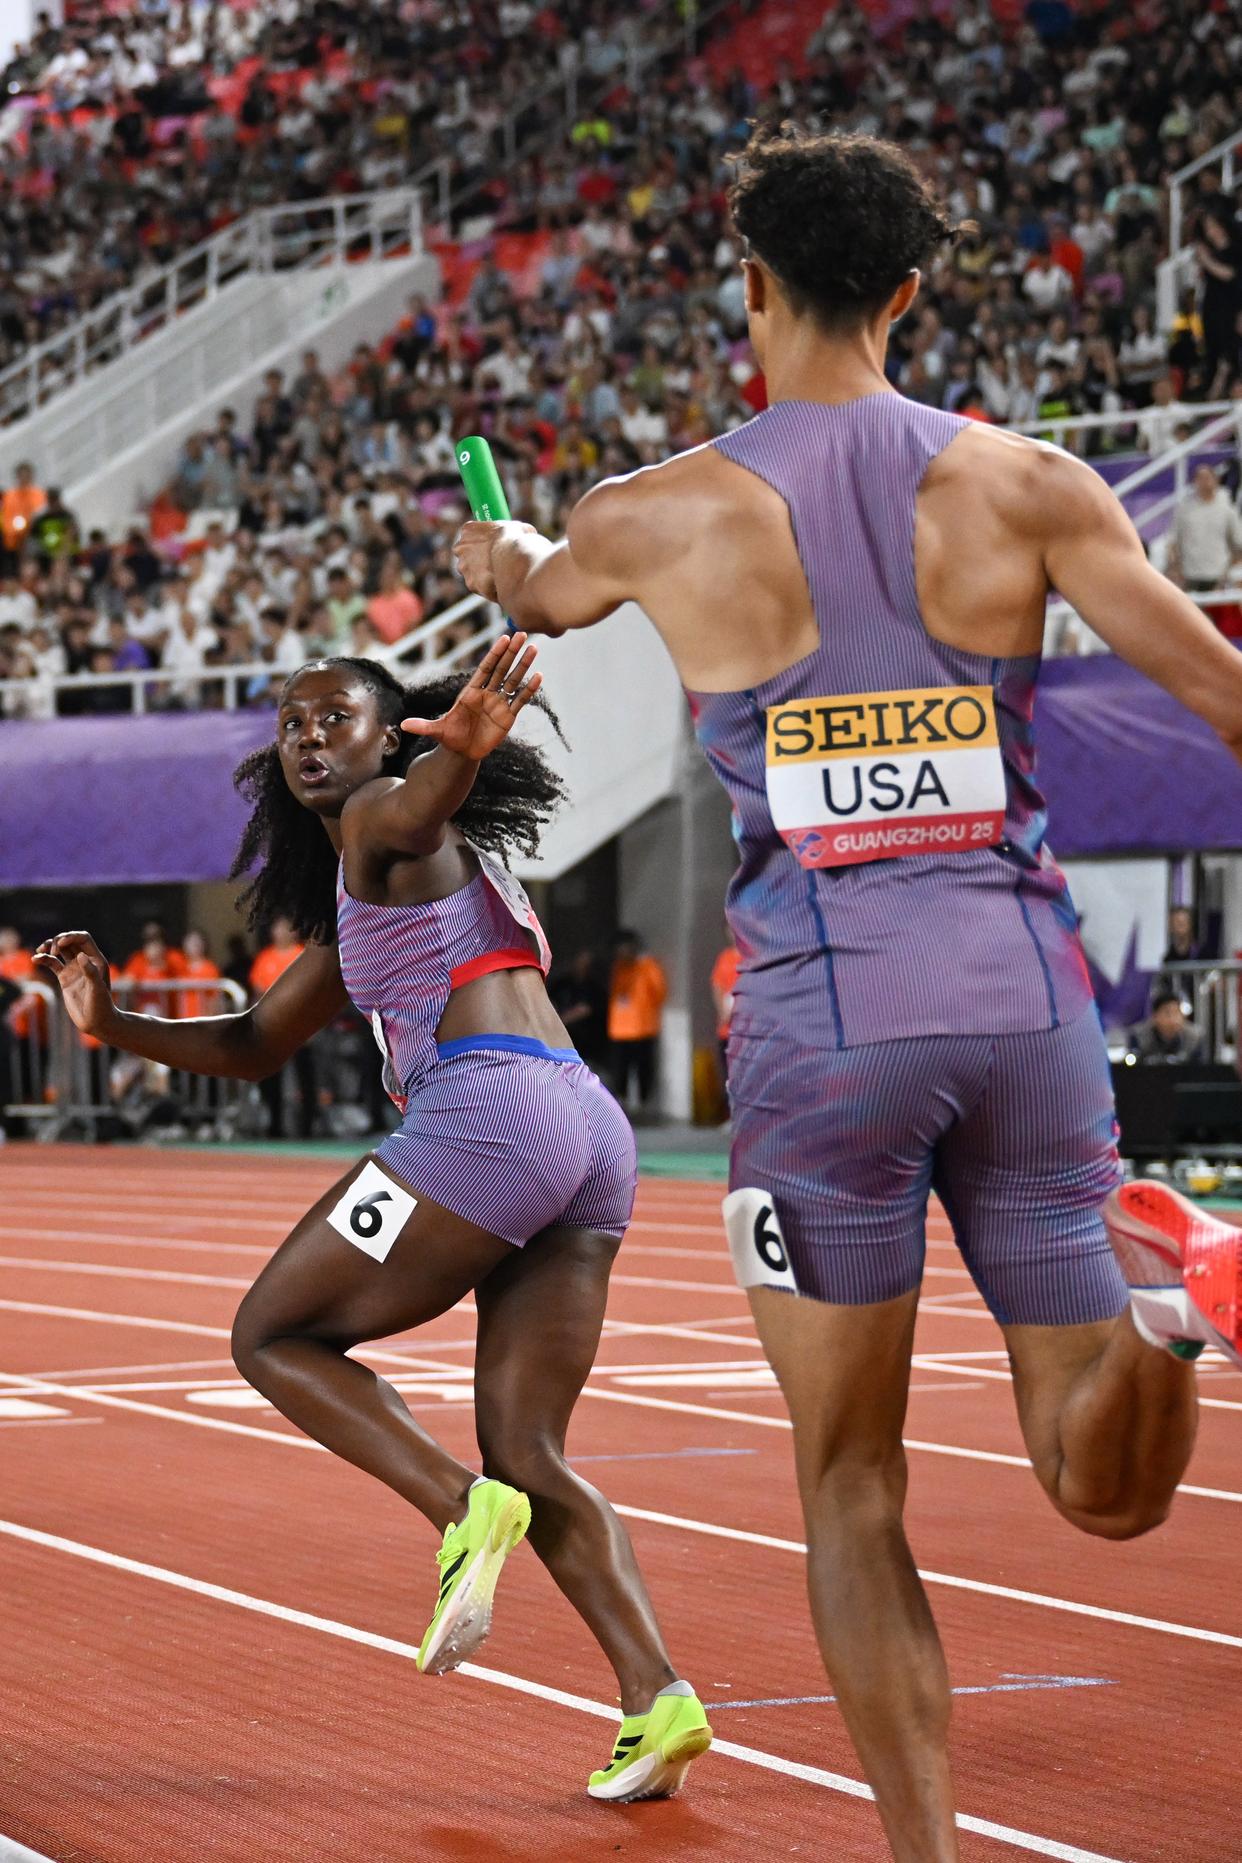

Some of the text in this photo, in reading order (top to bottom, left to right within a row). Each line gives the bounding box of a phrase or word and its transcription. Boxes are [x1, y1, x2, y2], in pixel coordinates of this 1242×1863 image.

[773, 696, 987, 757] SEIKO
[822, 760, 951, 816] USA
[833, 821, 994, 854] GUANGZHOU 25
[350, 1190, 394, 1239] 6
[754, 1205, 788, 1272] 6
